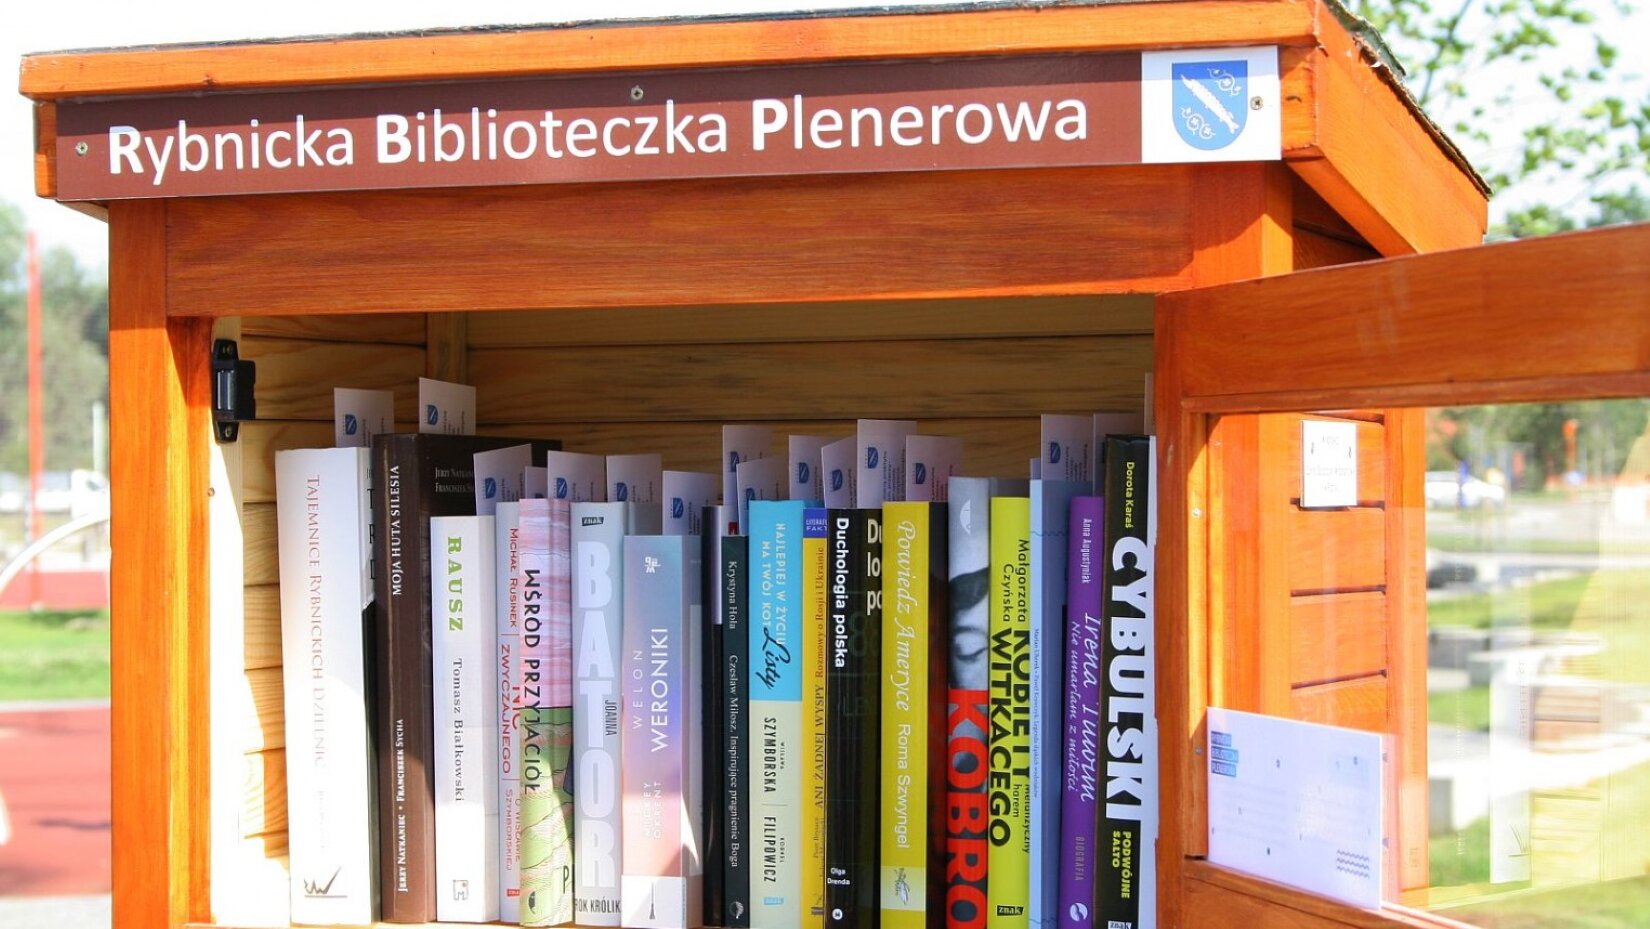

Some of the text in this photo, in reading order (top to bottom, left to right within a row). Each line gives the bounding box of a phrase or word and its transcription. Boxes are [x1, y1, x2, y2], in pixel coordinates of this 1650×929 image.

[110, 94, 1088, 185] Rybnicka Biblioteczka Plenerowa
[307, 474, 320, 567] TAJEMNICE
[389, 465, 404, 595] MOJA HUTA SILESIA
[1124, 461, 1135, 528] Dorota Karaś
[447, 536, 463, 631] RAUSZ
[727, 561, 738, 604] Krystyna
[762, 541, 772, 627] MA TWÓJ KOT
[775, 523, 787, 646] NAJLEPIEJ W ŻYCIU
[815, 547, 825, 590] Ukrainie
[1017, 539, 1030, 622] Małgorzata
[1080, 518, 1093, 584] Anna Augustyniak
[310, 575, 324, 680] RYBNICKICH
[815, 597, 826, 621] Rosji
[832, 517, 850, 668] Duchologia polska
[890, 520, 918, 712] Powiedz Ameryce
[1000, 563, 1014, 622] Czyńska
[524, 569, 543, 795] WŚRÓD PRZYJACIÓŁ
[728, 655, 739, 694] Czesław
[755, 626, 791, 691] Listy
[815, 629, 826, 679] Rozmowy
[1083, 612, 1101, 688] Irena
[1106, 536, 1148, 821] CYBULSKI
[501, 644, 511, 774] ZWYCZAJNEGO
[577, 541, 616, 888] BATOR
[604, 700, 617, 736] JOANNA
[632, 650, 643, 730] WELON
[651, 628, 669, 753] WERONIKI
[814, 685, 825, 728] WYSPY
[1013, 630, 1030, 782] KOBIETY
[1067, 620, 1082, 792] Nie umarłam z miłości
[452, 659, 465, 802] Tomasz Białkowski
[728, 735, 740, 789] Inspirujące
[763, 717, 777, 793] SZYMBORSKA
[814, 733, 825, 780] ŻADNEJ
[989, 628, 1012, 847] WITKACEGO
[728, 790, 740, 840] pragnienie
[814, 786, 825, 809] ANI
[894, 723, 911, 848] Roma Szwyngel
[946, 689, 988, 929] KOBRO
[1012, 783, 1022, 818] harem
[731, 842, 741, 867] Boga
[763, 816, 777, 883] FILIPOWICZ
[830, 867, 846, 876] Olga
[1074, 836, 1085, 881] BIOGRAFIA
[1112, 830, 1121, 868] SALTO
[1120, 830, 1133, 899] PODWÓJNE
[997, 905, 1023, 916] znak
